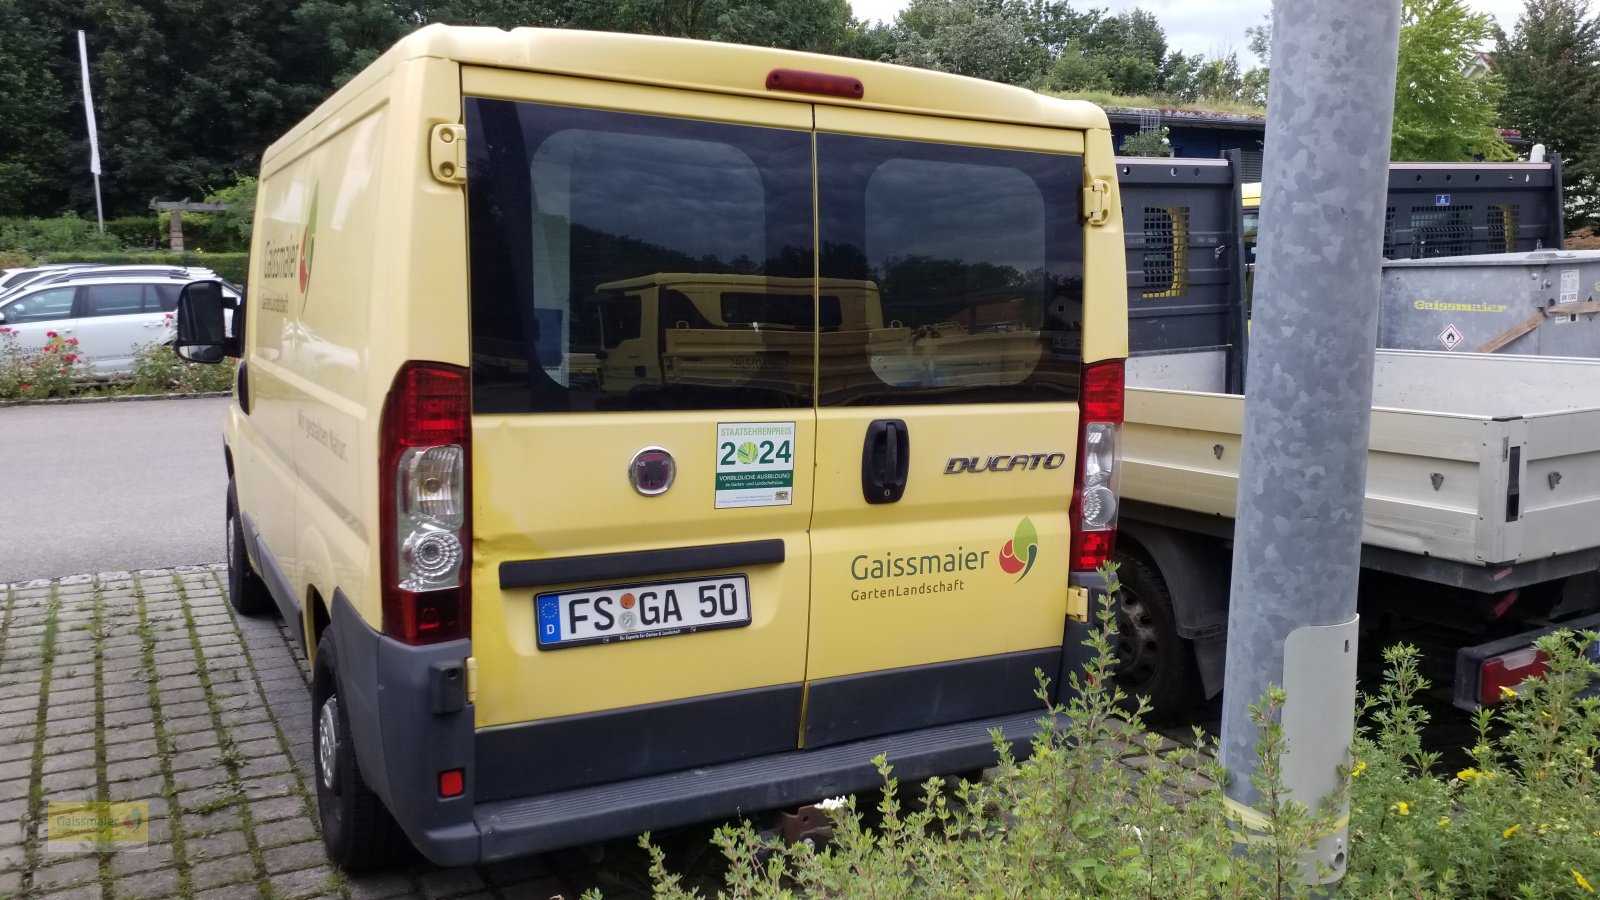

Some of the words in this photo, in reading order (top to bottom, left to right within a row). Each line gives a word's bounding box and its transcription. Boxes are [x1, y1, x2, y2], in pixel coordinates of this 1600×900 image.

[1414, 299, 1506, 312] Gaissmaier
[720, 426, 792, 437] STAATSEHRENPREIS
[943, 452, 1066, 475] DUCATO
[851, 546, 990, 581] Gaissmaier
[851, 580, 965, 601] GartenLandschaft
[568, 596, 615, 634] FS
[639, 589, 683, 626] GA
[699, 583, 738, 618] 50
[546, 624, 555, 635] D
